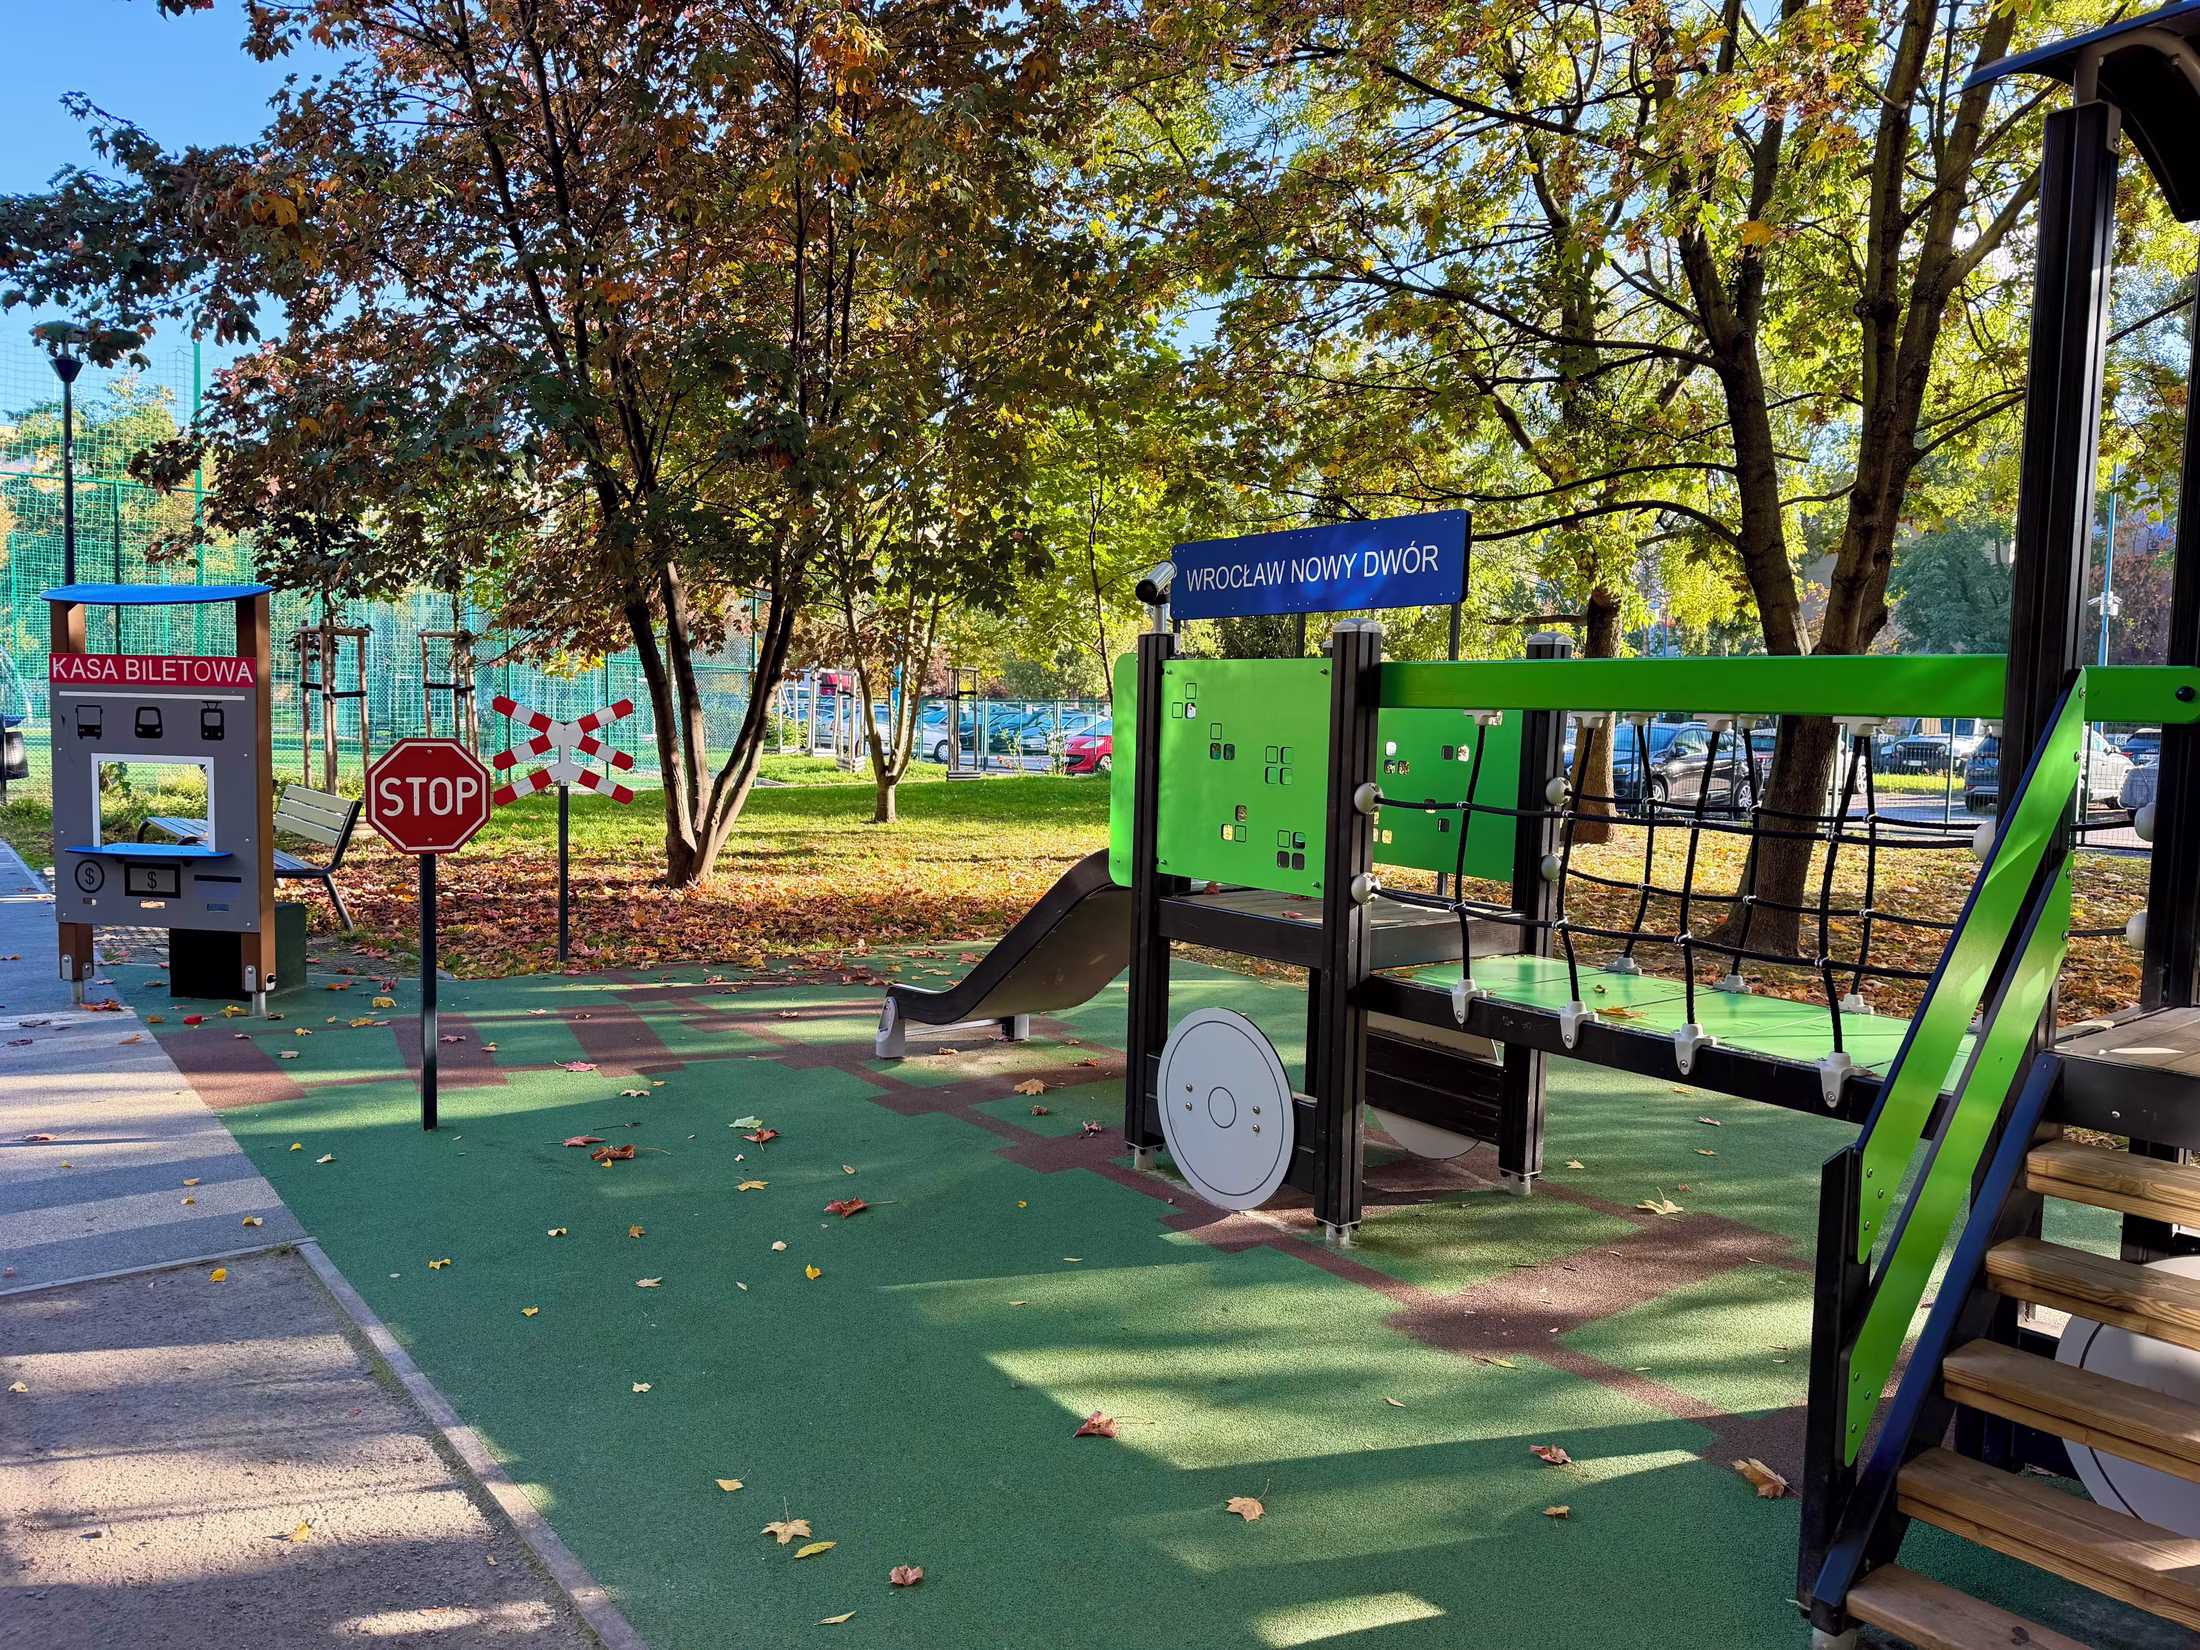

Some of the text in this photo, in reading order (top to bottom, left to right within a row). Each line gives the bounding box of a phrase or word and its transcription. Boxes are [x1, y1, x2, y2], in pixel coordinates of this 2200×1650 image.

[1186, 540, 1439, 592] WROCŁAW NOWY DWÓR
[52, 657, 254, 683] KASA BILETOWA
[379, 776, 478, 817] STOP
